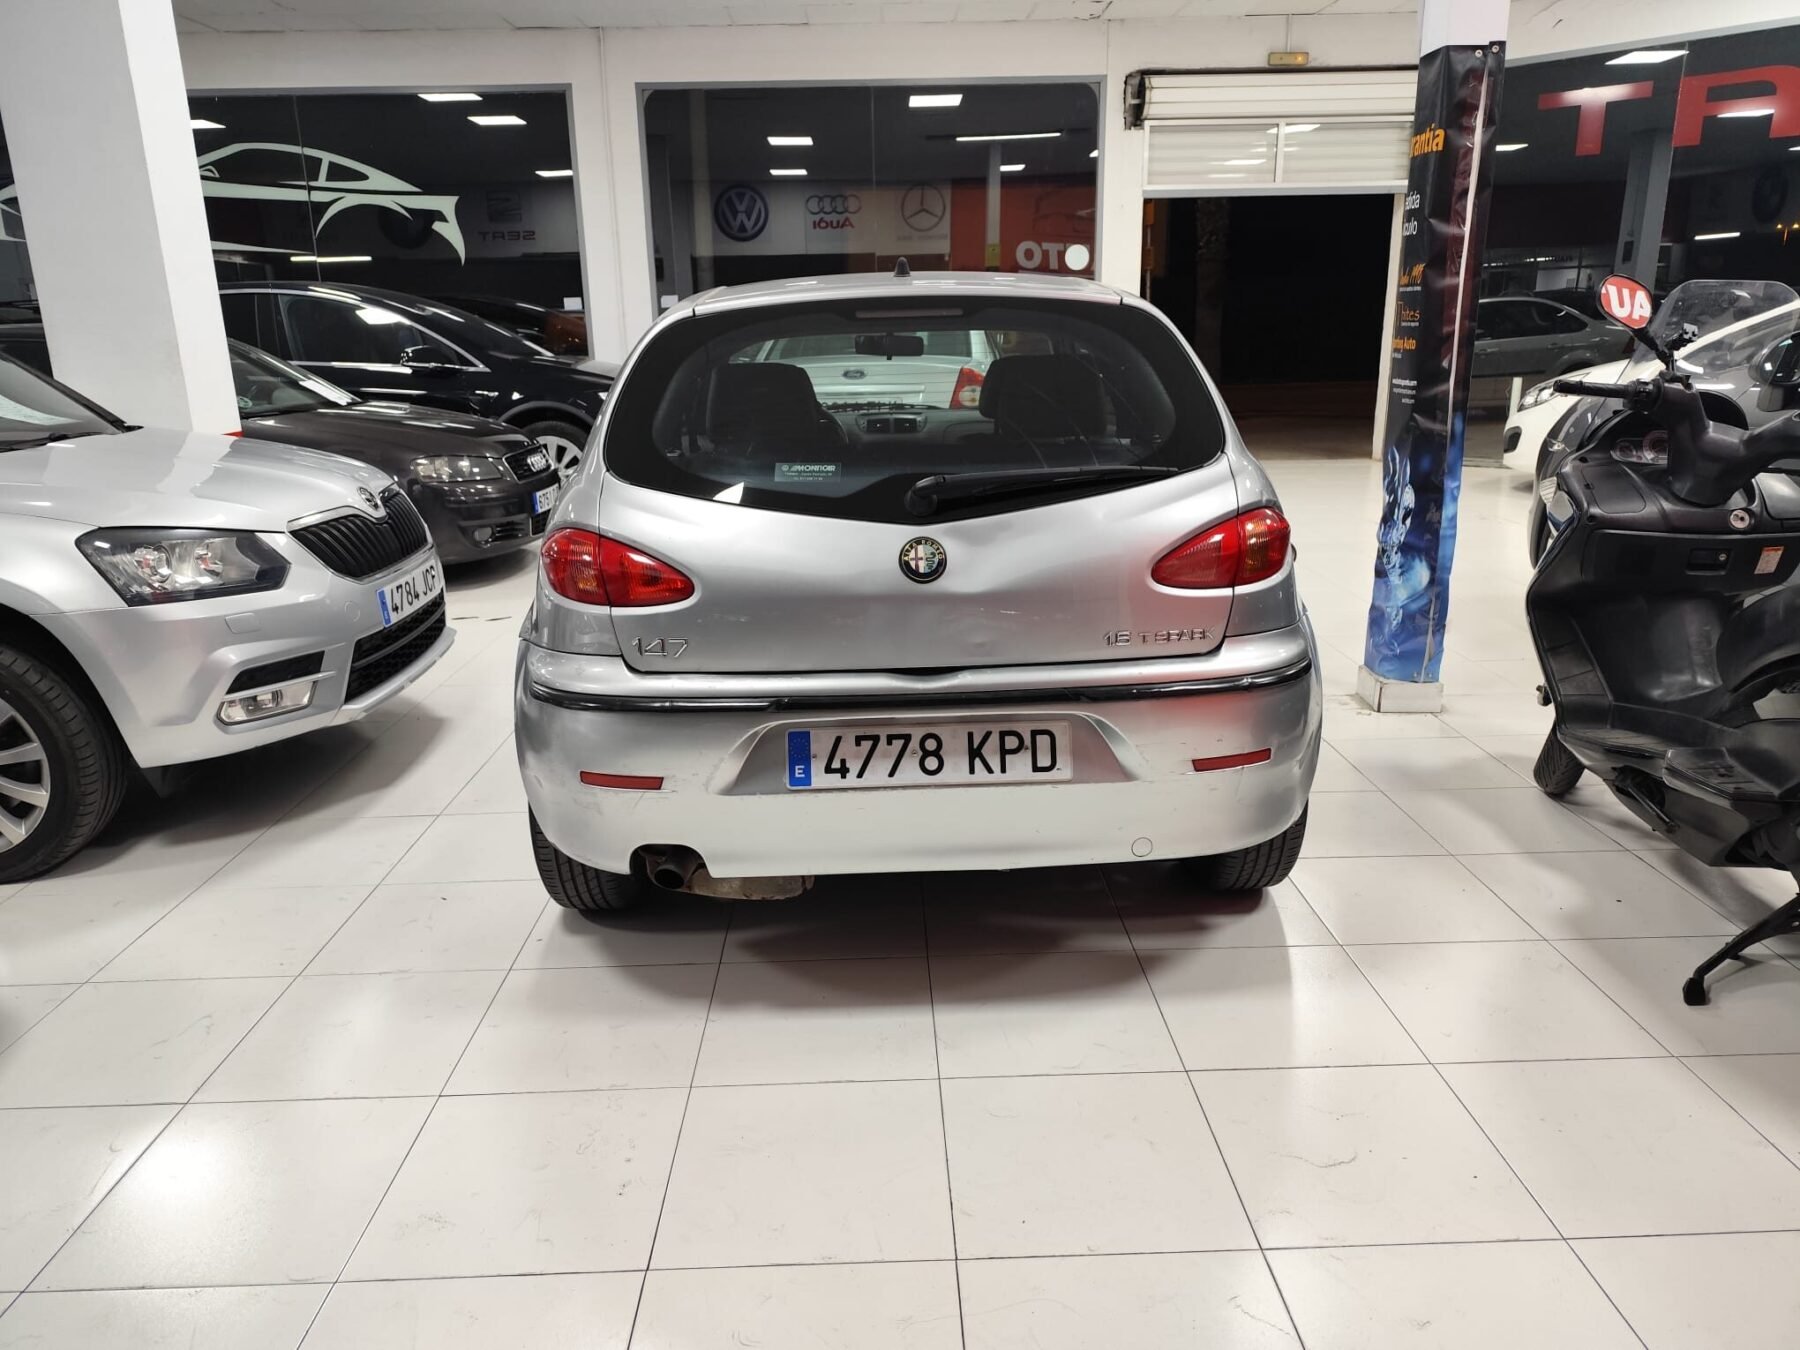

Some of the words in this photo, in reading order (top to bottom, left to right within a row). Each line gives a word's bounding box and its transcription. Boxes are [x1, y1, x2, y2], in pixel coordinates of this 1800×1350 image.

[921, 539, 944, 560] ROMEO
[390, 576, 420, 615] 4784
[632, 636, 688, 658] 147
[794, 765, 805, 778] E
[824, 732, 945, 780] 4778
[966, 729, 1058, 775] KPD
